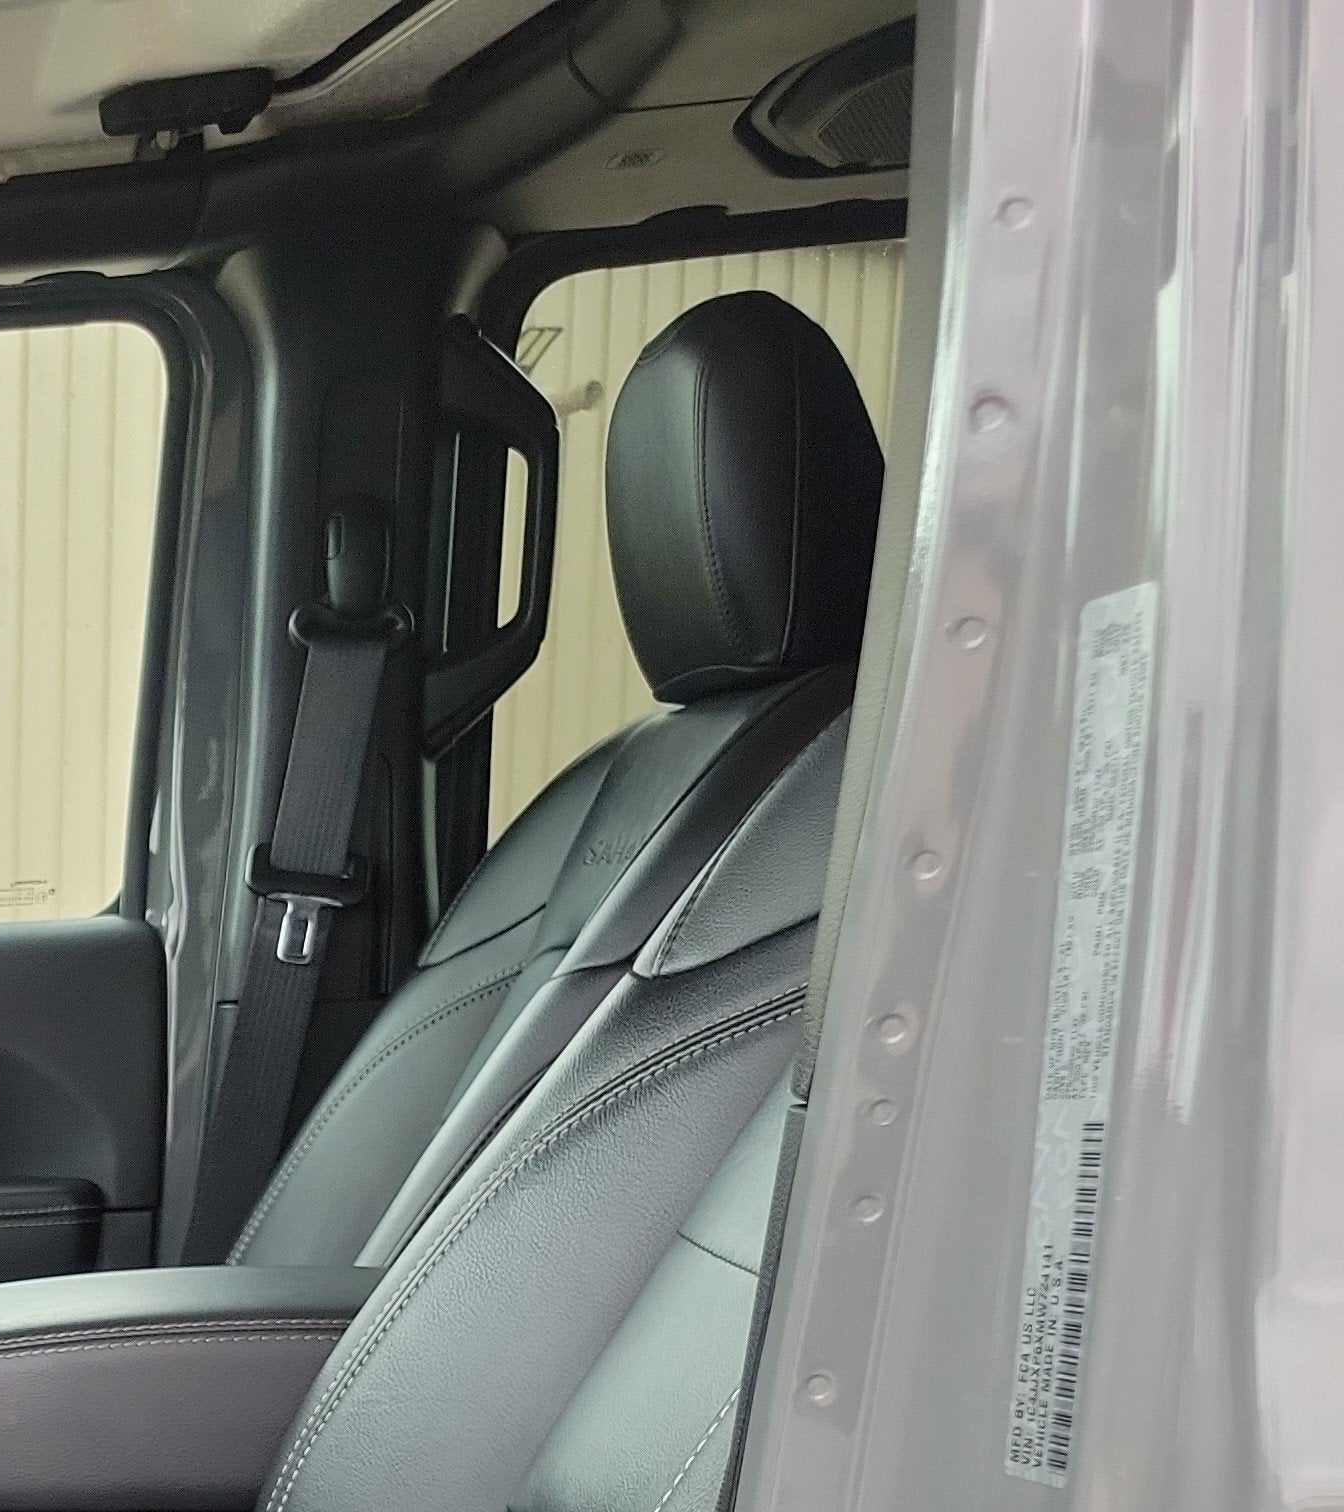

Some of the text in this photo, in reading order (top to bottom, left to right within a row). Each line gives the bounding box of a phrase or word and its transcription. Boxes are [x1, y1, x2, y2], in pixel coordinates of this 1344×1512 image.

[1024, 1287, 1036, 1316] LLC
[1022, 1323, 1032, 1345] US
[1018, 1353, 1030, 1383] FCA
[1033, 1401, 1048, 1467] VEHICLE
[1041, 1347, 1053, 1392] MADE
[1010, 1426, 1021, 1462] MFD
[1021, 1431, 1032, 1464] VIN:
